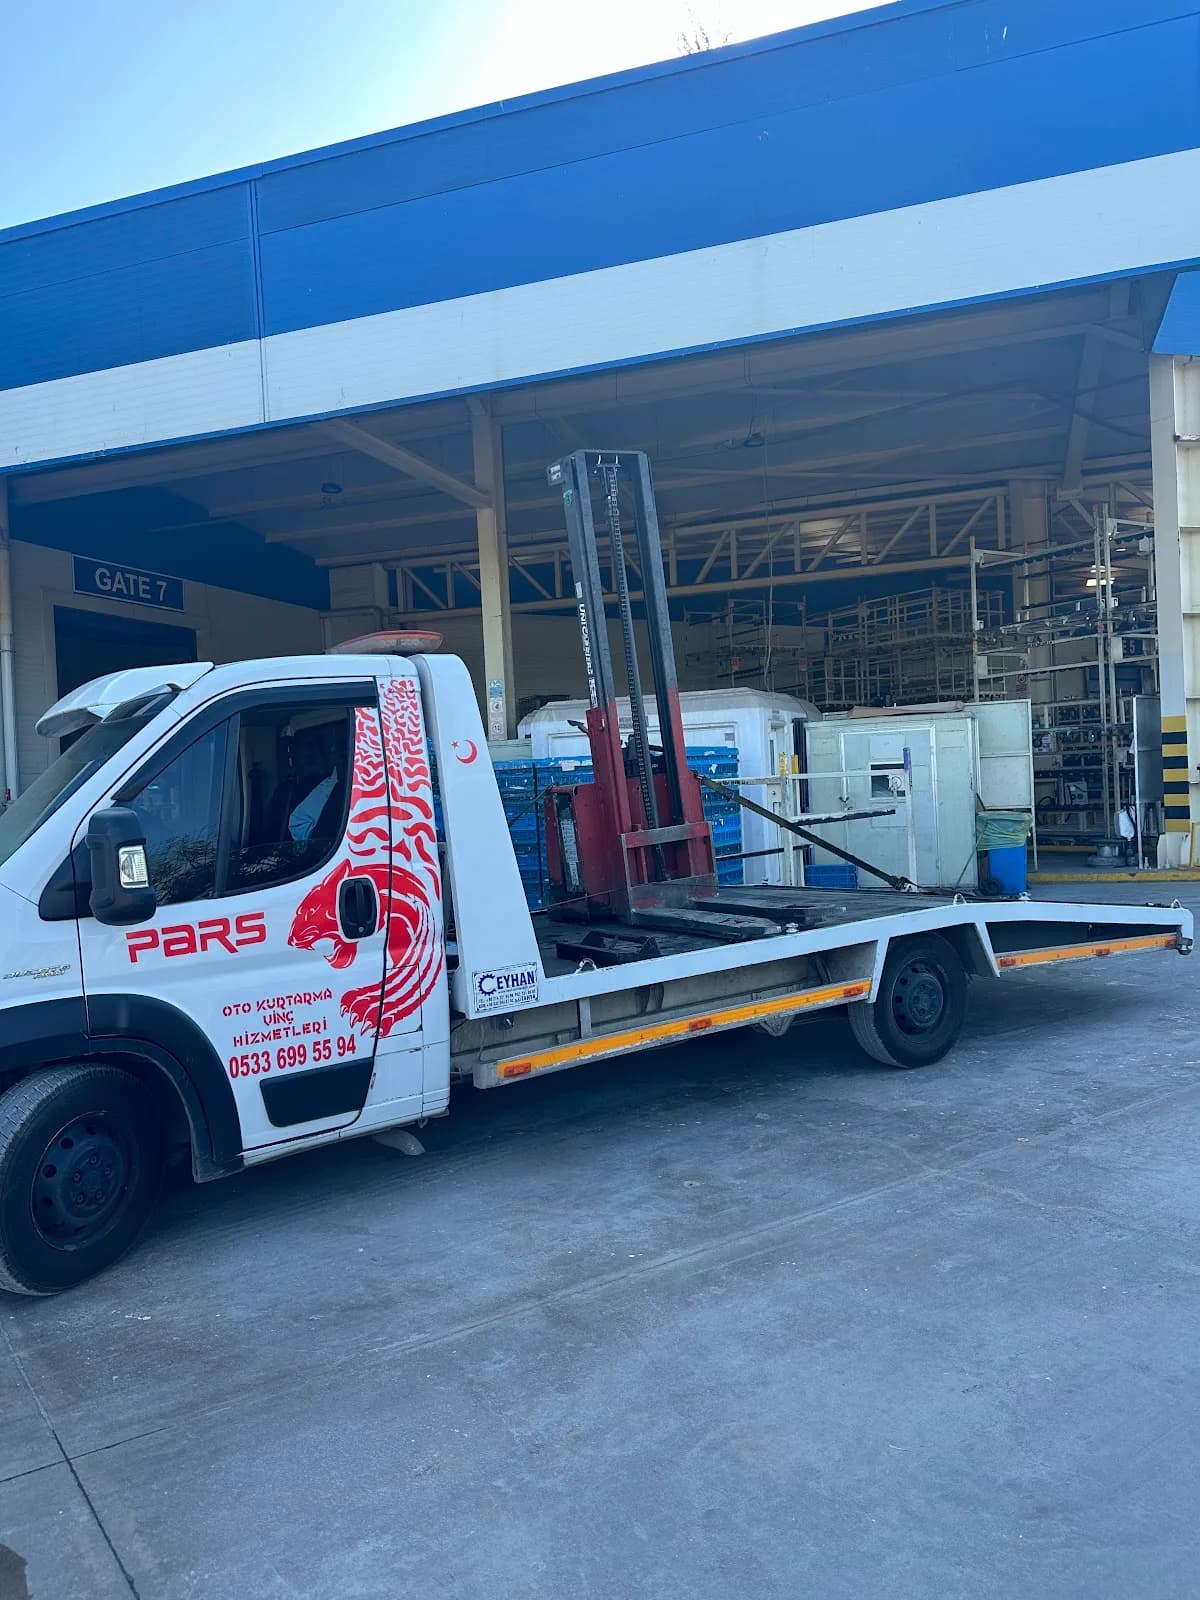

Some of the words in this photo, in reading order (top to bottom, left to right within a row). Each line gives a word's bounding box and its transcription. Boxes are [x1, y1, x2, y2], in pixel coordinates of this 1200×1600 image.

[95, 567, 151, 599] GATE
[156, 580, 168, 601] 7
[222, 1002, 252, 1017] OTO
[256, 988, 333, 1012] KURTARMA
[233, 1016, 328, 1047] HİZMETLERİ
[229, 1050, 272, 1079] 0533
[276, 1043, 307, 1069] 699
[312, 1038, 332, 1062] 55
[336, 1033, 357, 1057] 94
